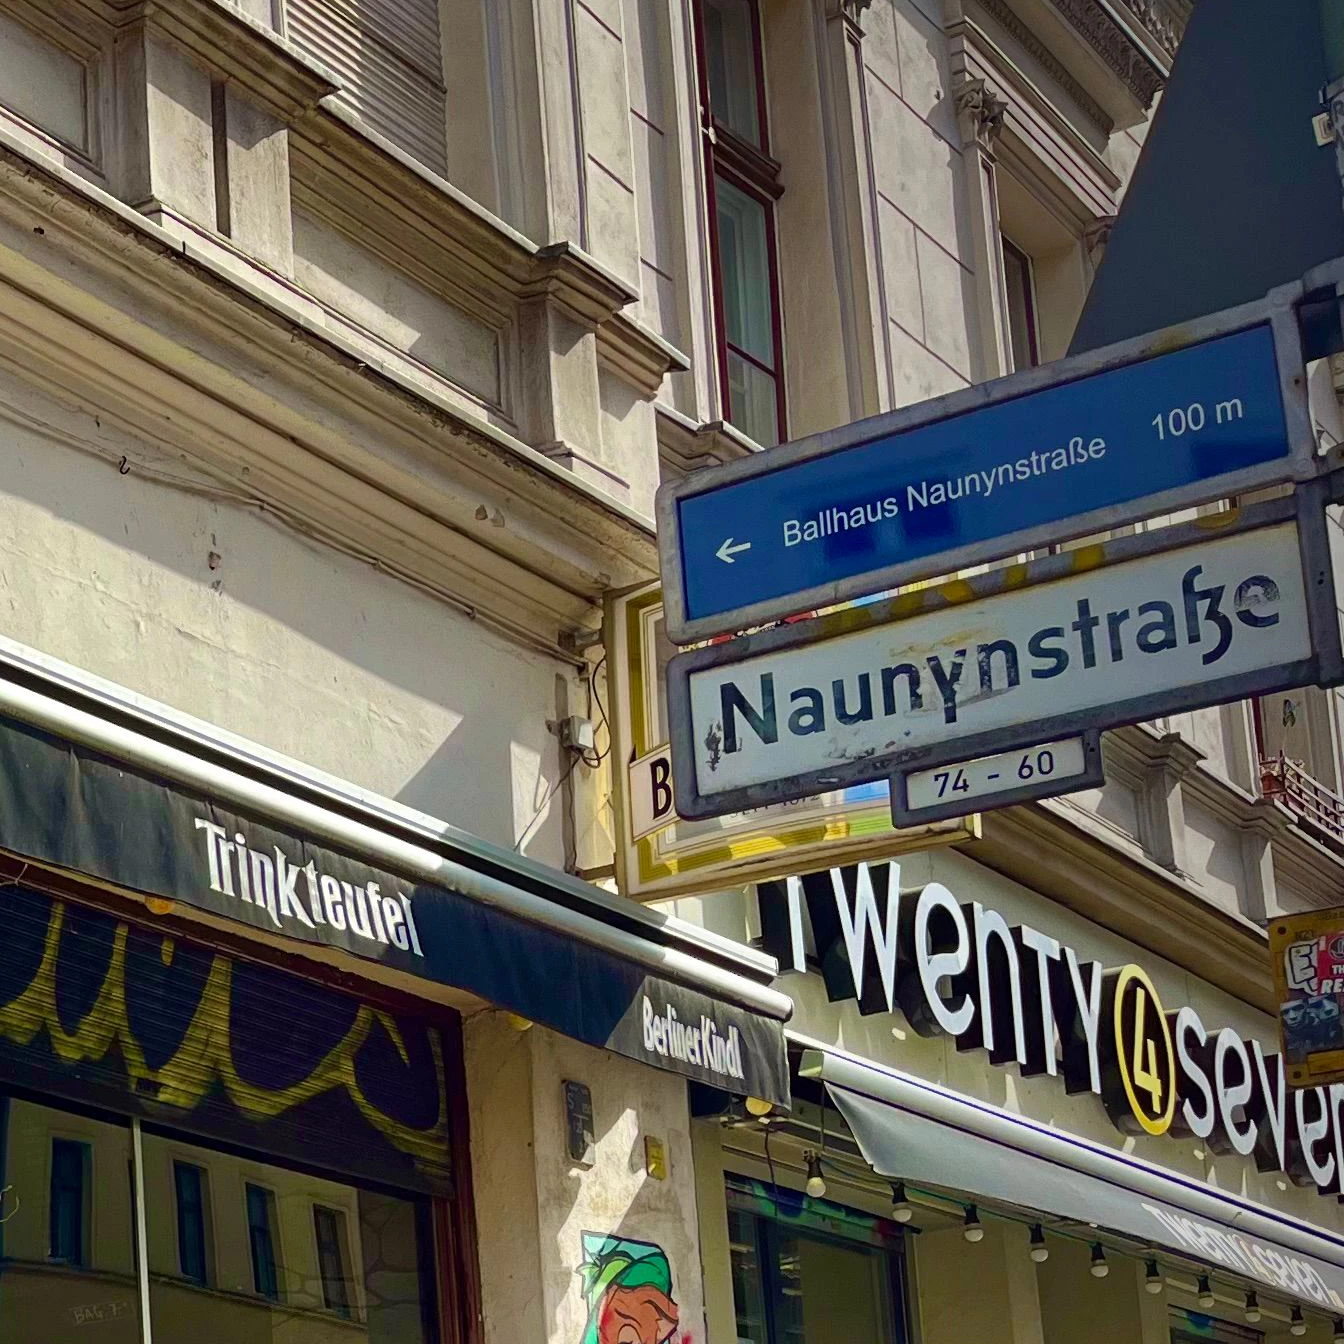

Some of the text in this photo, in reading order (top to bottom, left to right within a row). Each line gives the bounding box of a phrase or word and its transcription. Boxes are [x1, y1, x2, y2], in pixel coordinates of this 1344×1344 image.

[782, 396, 1244, 549] Ballhaus Naunynstraße 100 m
[718, 565, 1281, 757] Naunynstraße
[933, 770, 970, 798] 74
[1018, 750, 1055, 779] 60
[194, 818, 424, 958] Trinkteufel
